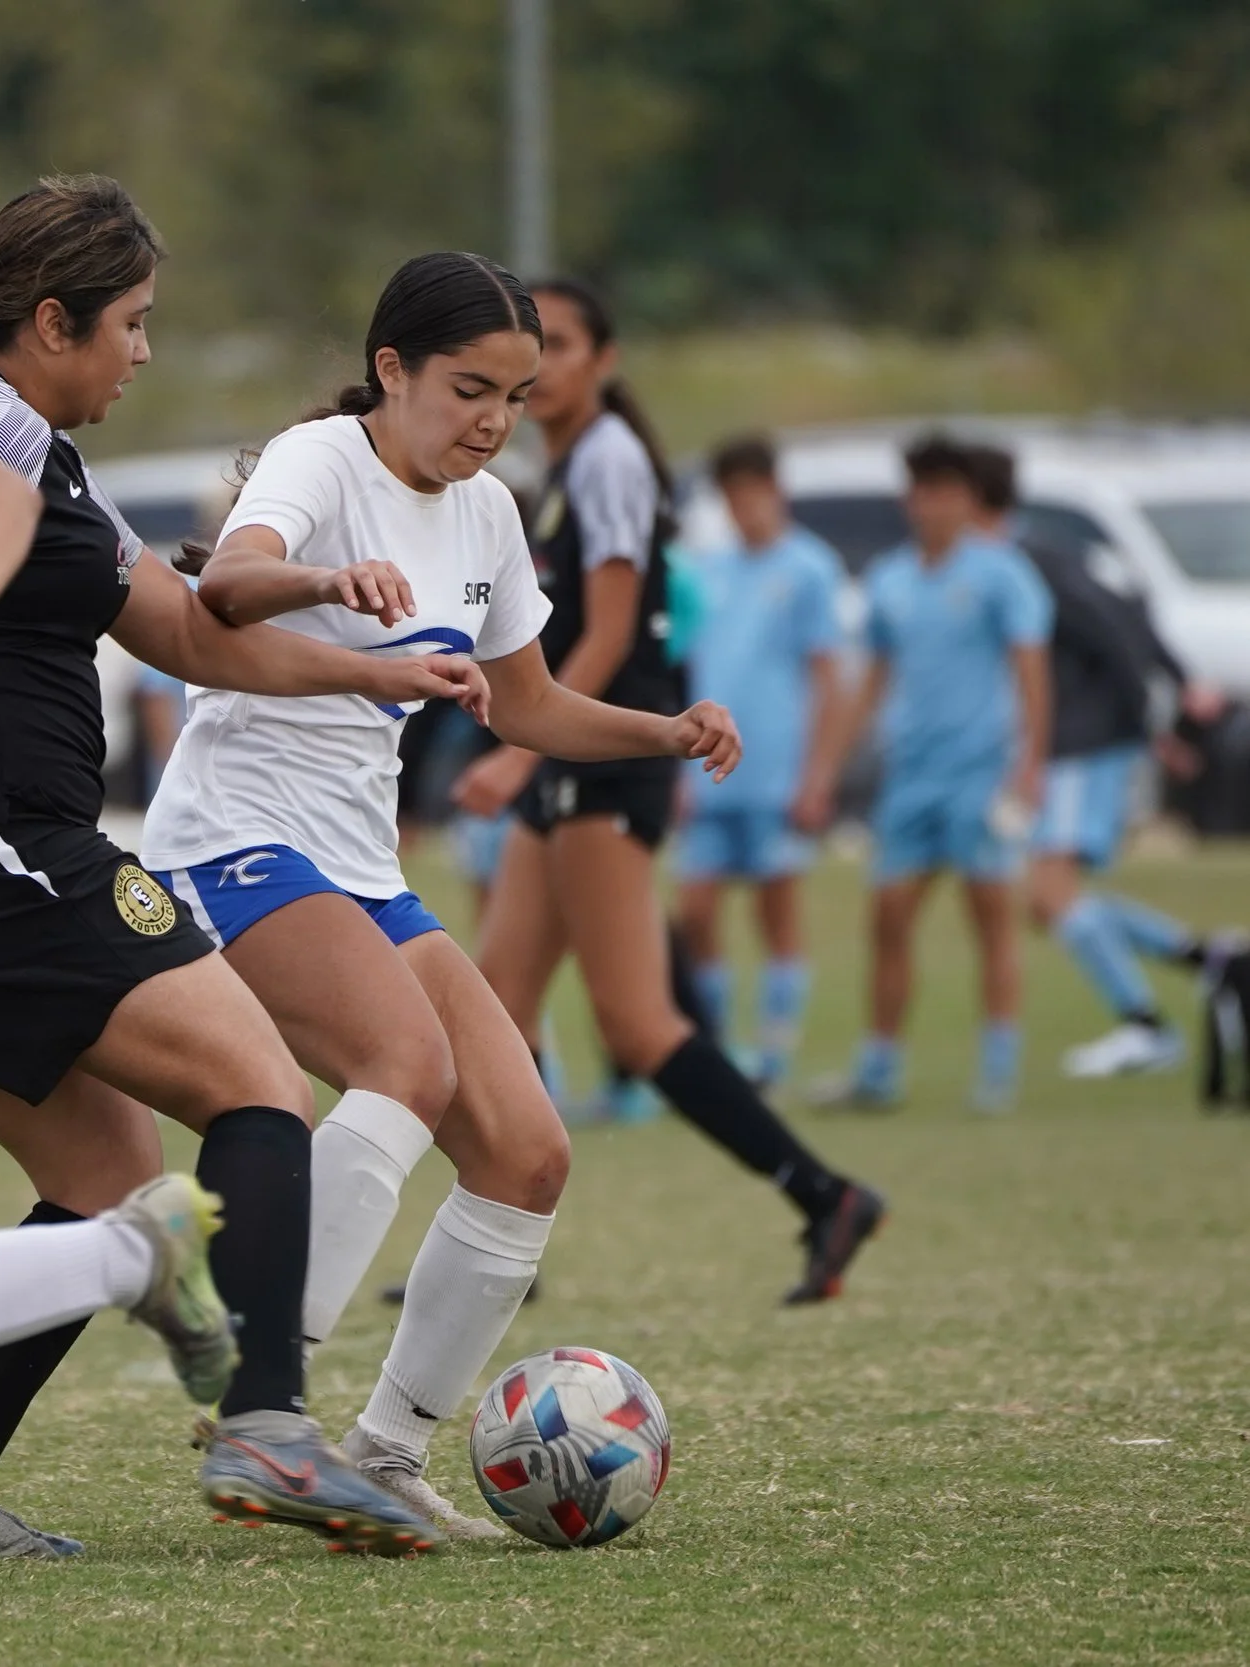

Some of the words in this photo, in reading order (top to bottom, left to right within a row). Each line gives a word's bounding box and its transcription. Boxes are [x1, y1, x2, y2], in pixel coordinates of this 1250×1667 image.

[463, 582, 492, 605] SUR
[116, 872, 127, 901] SOCAL
[125, 867, 143, 877] ELITE
[131, 916, 174, 933] FOOTBALL
